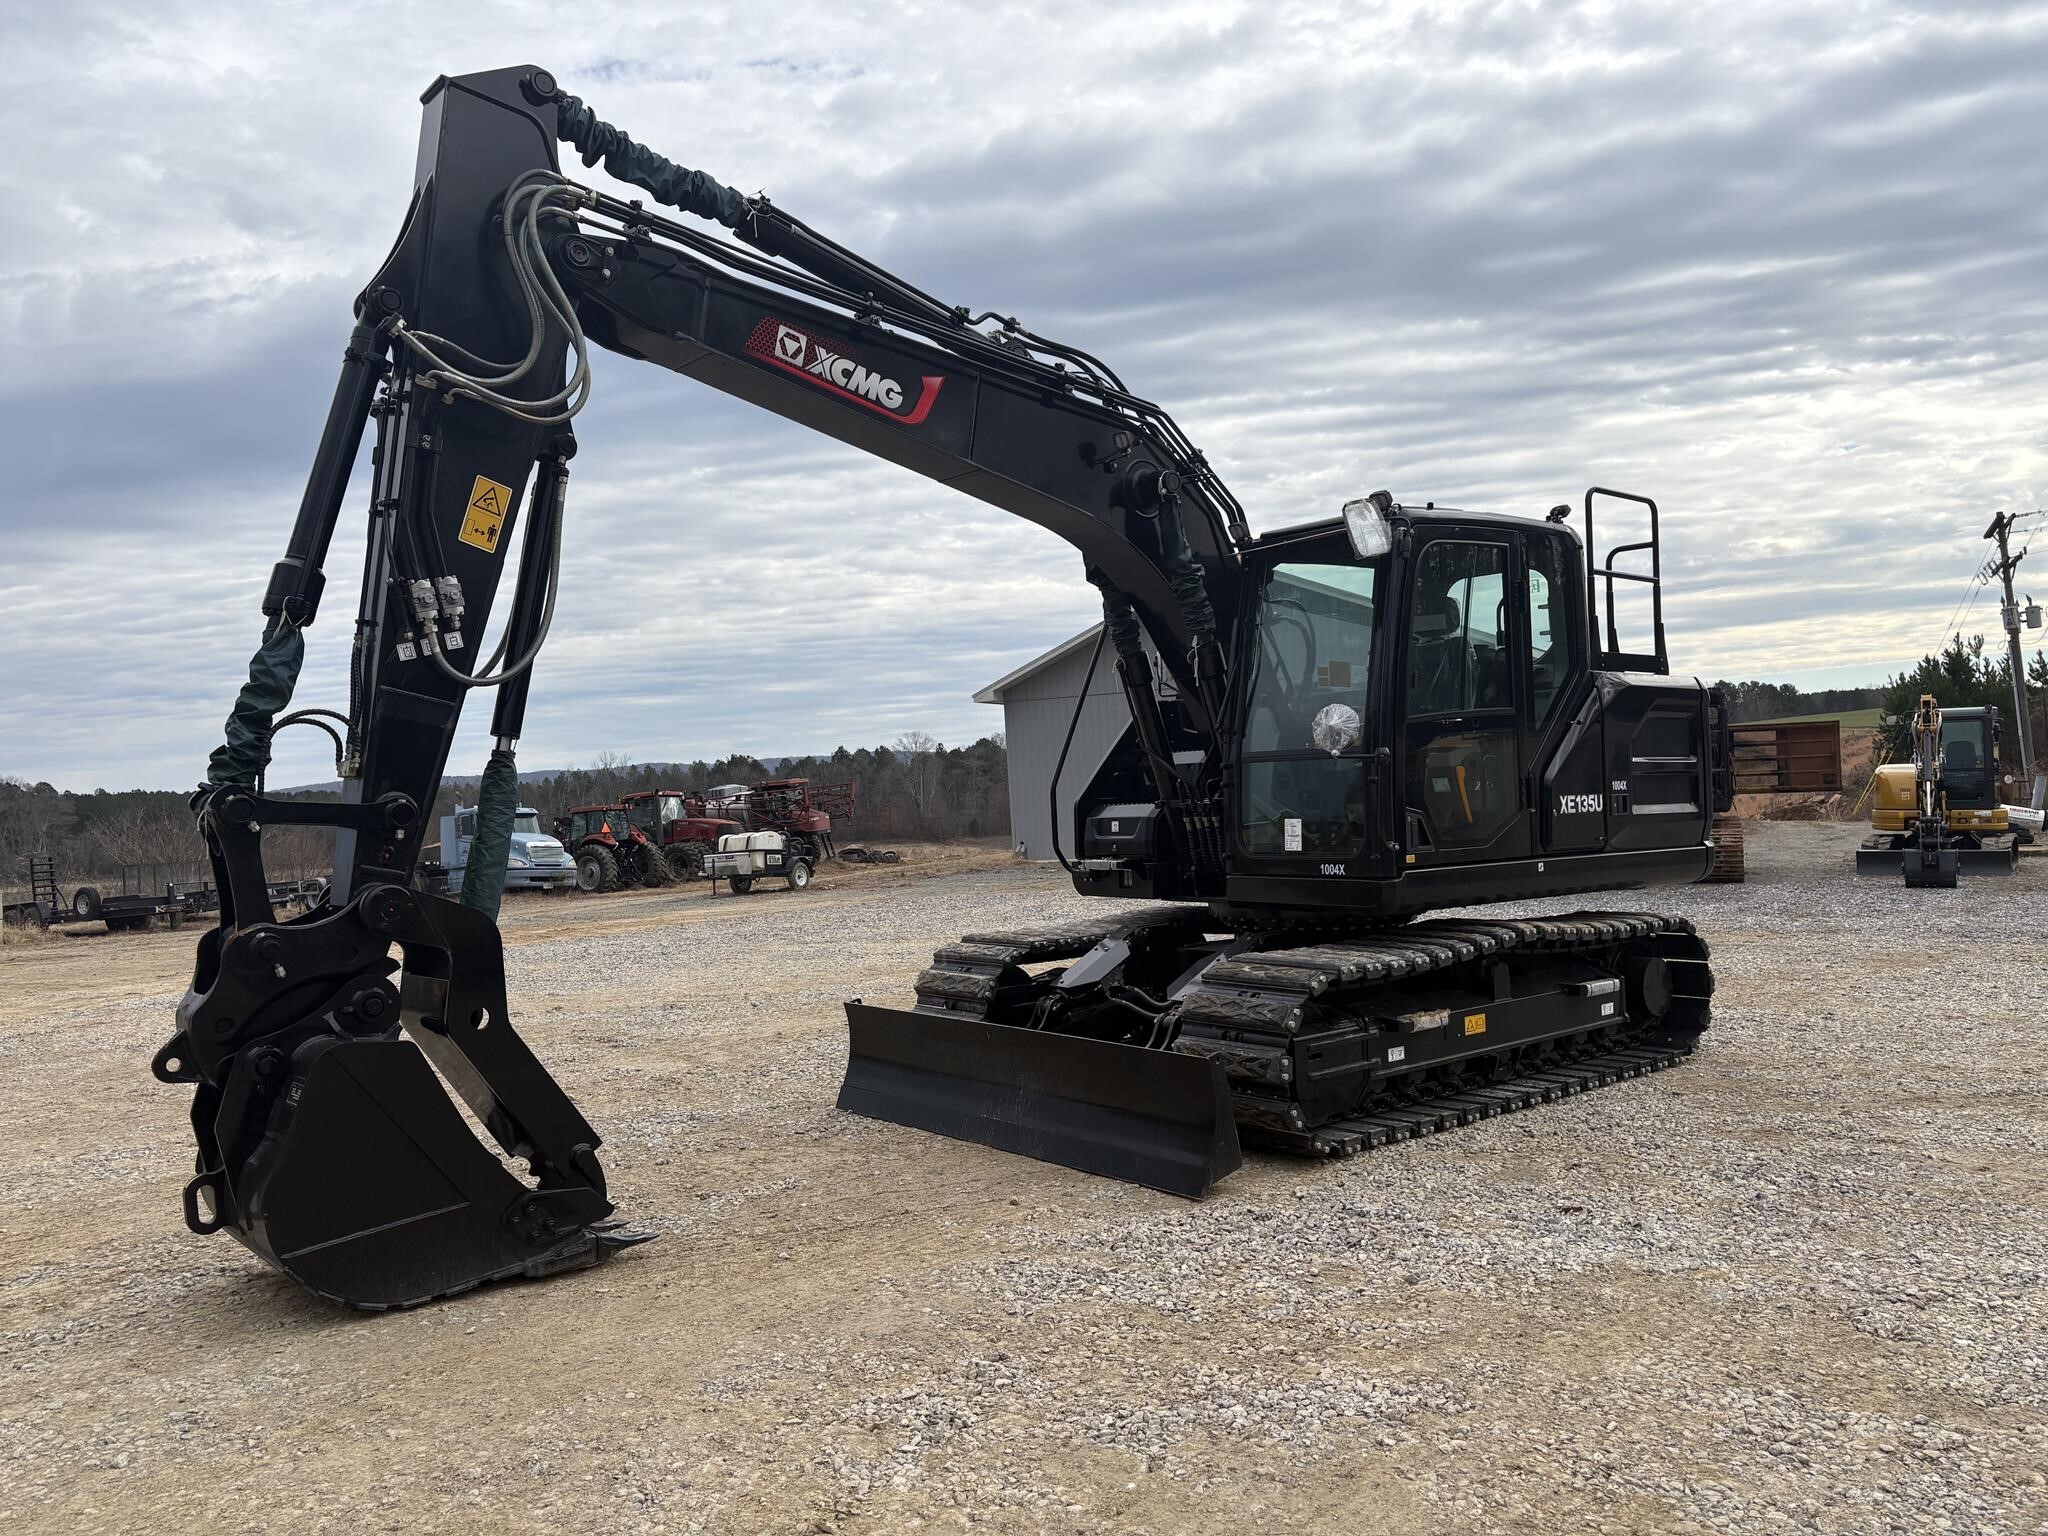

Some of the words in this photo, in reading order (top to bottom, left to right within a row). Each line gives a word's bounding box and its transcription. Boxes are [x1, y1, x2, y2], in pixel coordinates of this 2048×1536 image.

[806, 345, 903, 408] XCMG
[1611, 780, 1627, 790] 1004X
[1560, 794, 1603, 814] XE135U
[1320, 863, 1345, 875] 1004X
